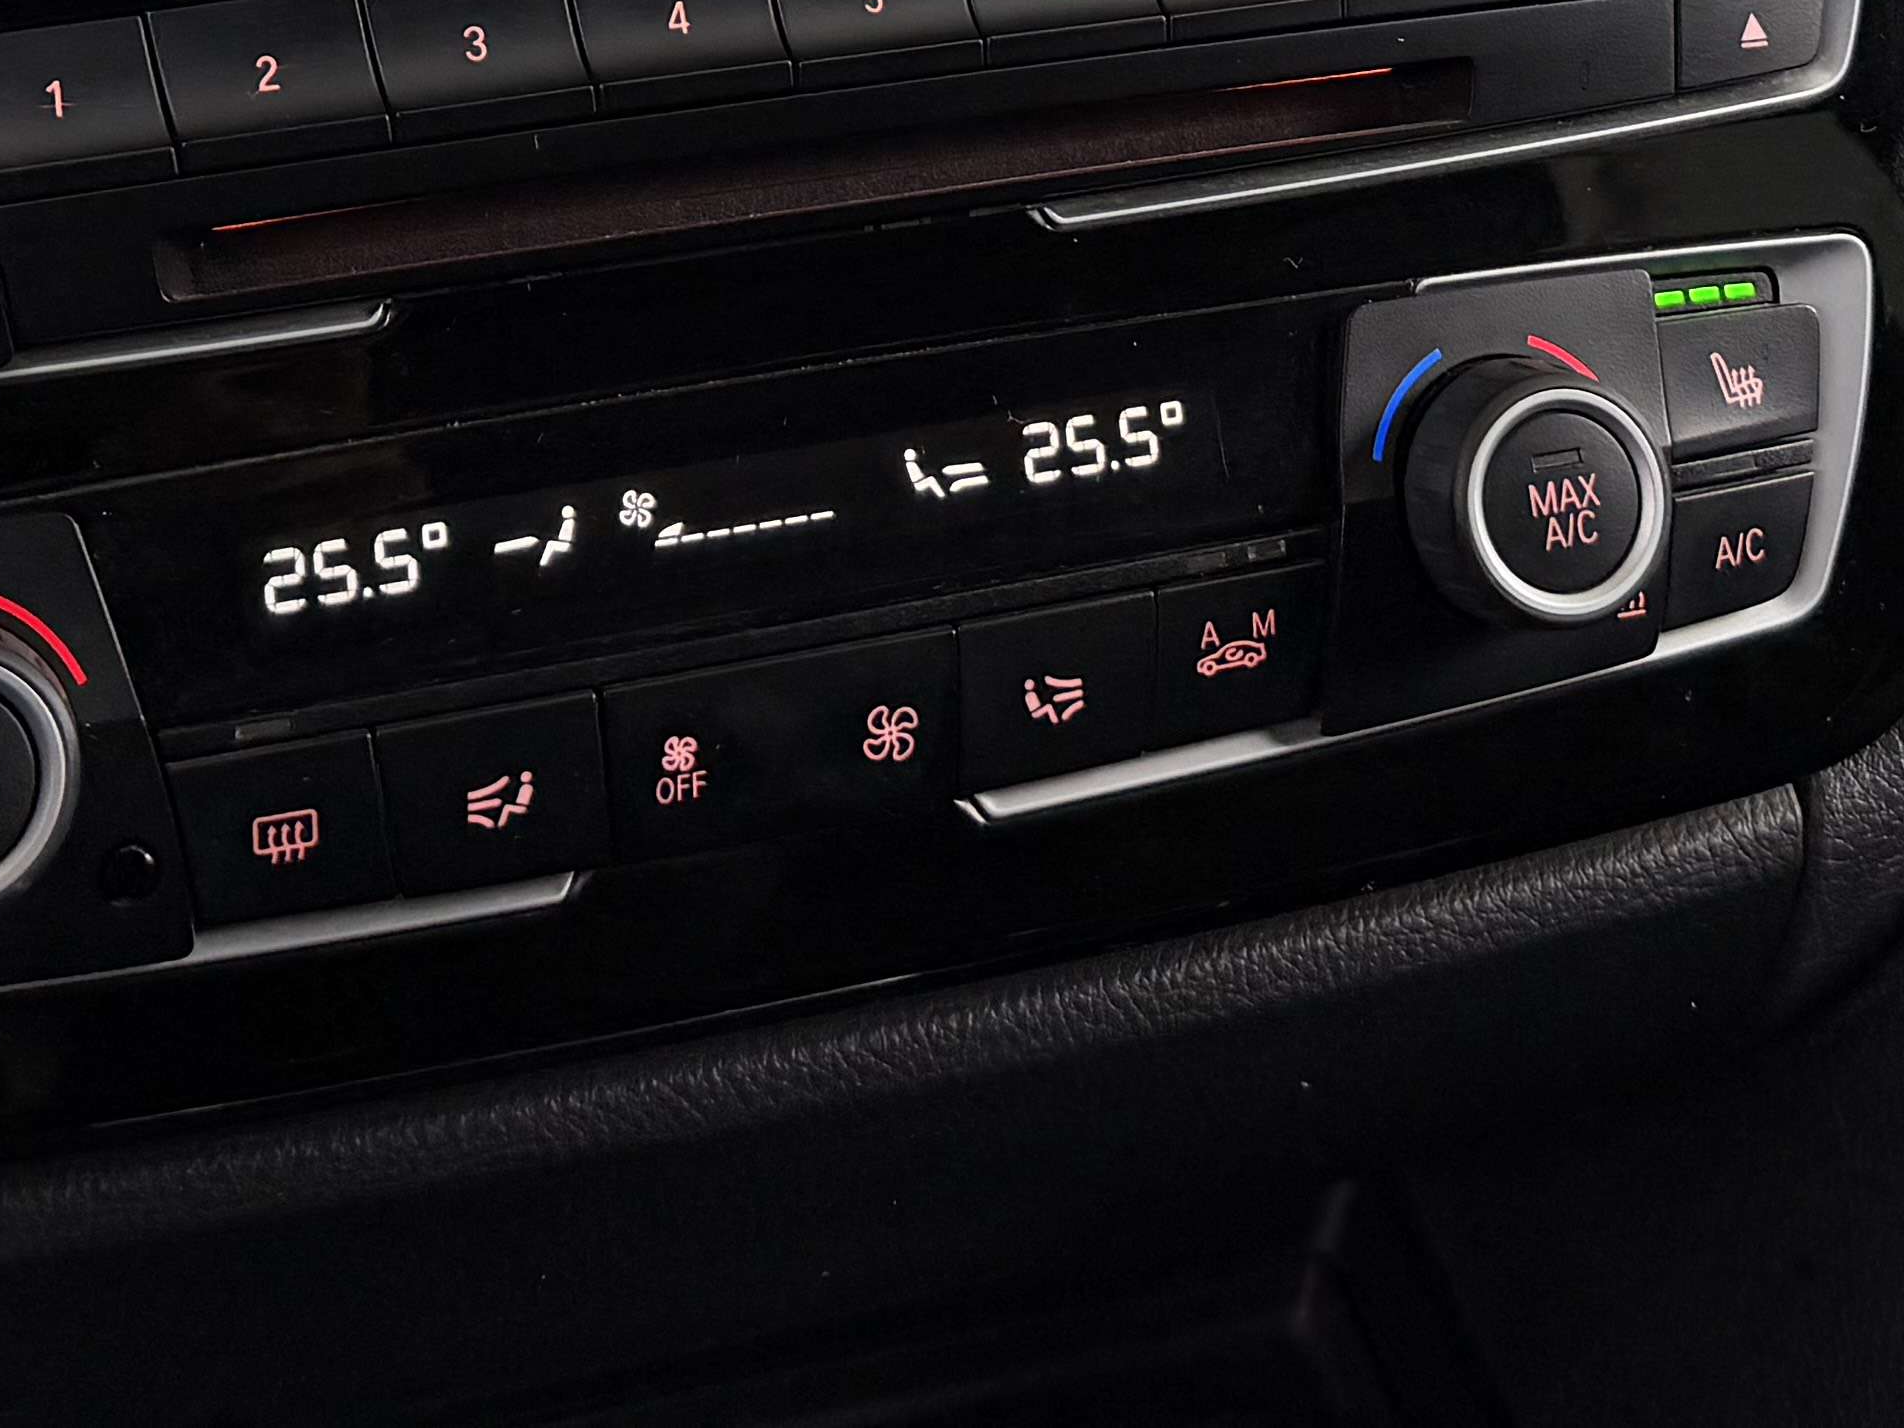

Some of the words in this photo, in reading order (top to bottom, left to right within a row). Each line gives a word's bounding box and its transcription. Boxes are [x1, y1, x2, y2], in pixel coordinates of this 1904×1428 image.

[667, 0, 691, 36] 4
[463, 25, 488, 63] 3
[254, 55, 281, 95] 2
[43, 79, 67, 120] 1
[1528, 472, 1602, 519] MAX
[1545, 510, 1600, 553] A/C
[1714, 527, 1766, 570] A/C
[1200, 620, 1220, 649] A
[1251, 608, 1277, 637] M
[654, 770, 708, 806] OFF
